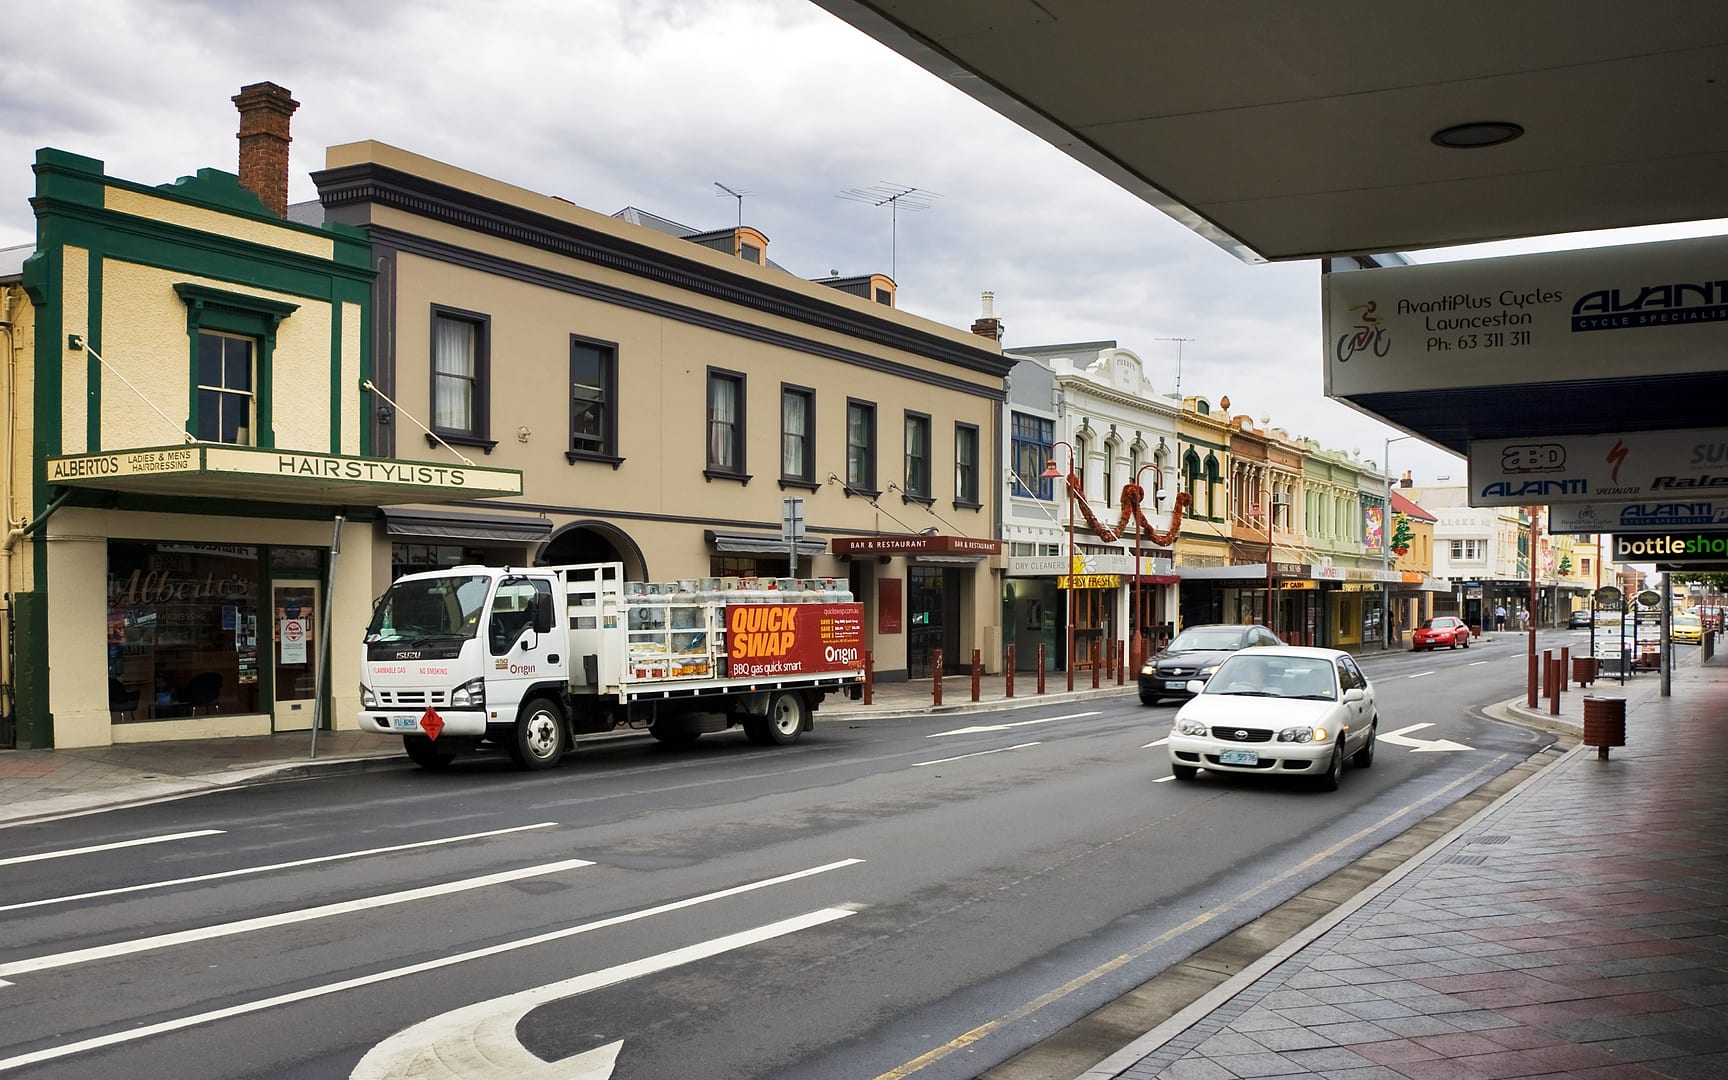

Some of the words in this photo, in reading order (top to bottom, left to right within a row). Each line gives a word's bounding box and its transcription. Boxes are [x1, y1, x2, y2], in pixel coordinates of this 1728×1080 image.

[1397, 294, 1491, 315] AvantiPlus
[1499, 288, 1563, 309] Cycles
[1426, 310, 1532, 331] Launceston
[1580, 317, 1629, 328] CYCLE
[1427, 337, 1451, 352] Ph:
[1458, 334, 1477, 350] 63
[1484, 332, 1503, 348] 311
[1510, 331, 1531, 346] 311
[128, 453, 154, 464] LADIES
[158, 453, 165, 462] &
[167, 451, 191, 460] MENS
[54, 456, 119, 478] ALBERTO'S
[132, 460, 188, 472] HAIRDRESSING
[279, 455, 465, 486] HAIRSTYLISTS
[1481, 479, 1587, 498] AVANTI
[1620, 503, 1712, 517] AVANTI
[850, 541, 865, 549] BAR
[876, 540, 927, 549] RESTAURANT
[969, 542, 995, 550] RESTAURANT
[1618, 535, 1728, 557] bottlesho
[1015, 562, 1029, 570] DRY
[1030, 561, 1066, 570] CLEANERS
[112, 568, 250, 608] Alberto's
[1088, 577, 1110, 587] FRESH
[731, 606, 798, 633] QUICK
[732, 632, 796, 658] SWAP
[396, 651, 421, 660] ISUZU
[825, 646, 857, 664] Origin
[398, 666, 407, 674] GAS
[419, 667, 426, 675] NO
[510, 664, 536, 676] Origin
[733, 663, 749, 676] BBQ
[751, 664, 763, 677] gas
[764, 660, 783, 676] quick
[783, 661, 802, 672] smart
